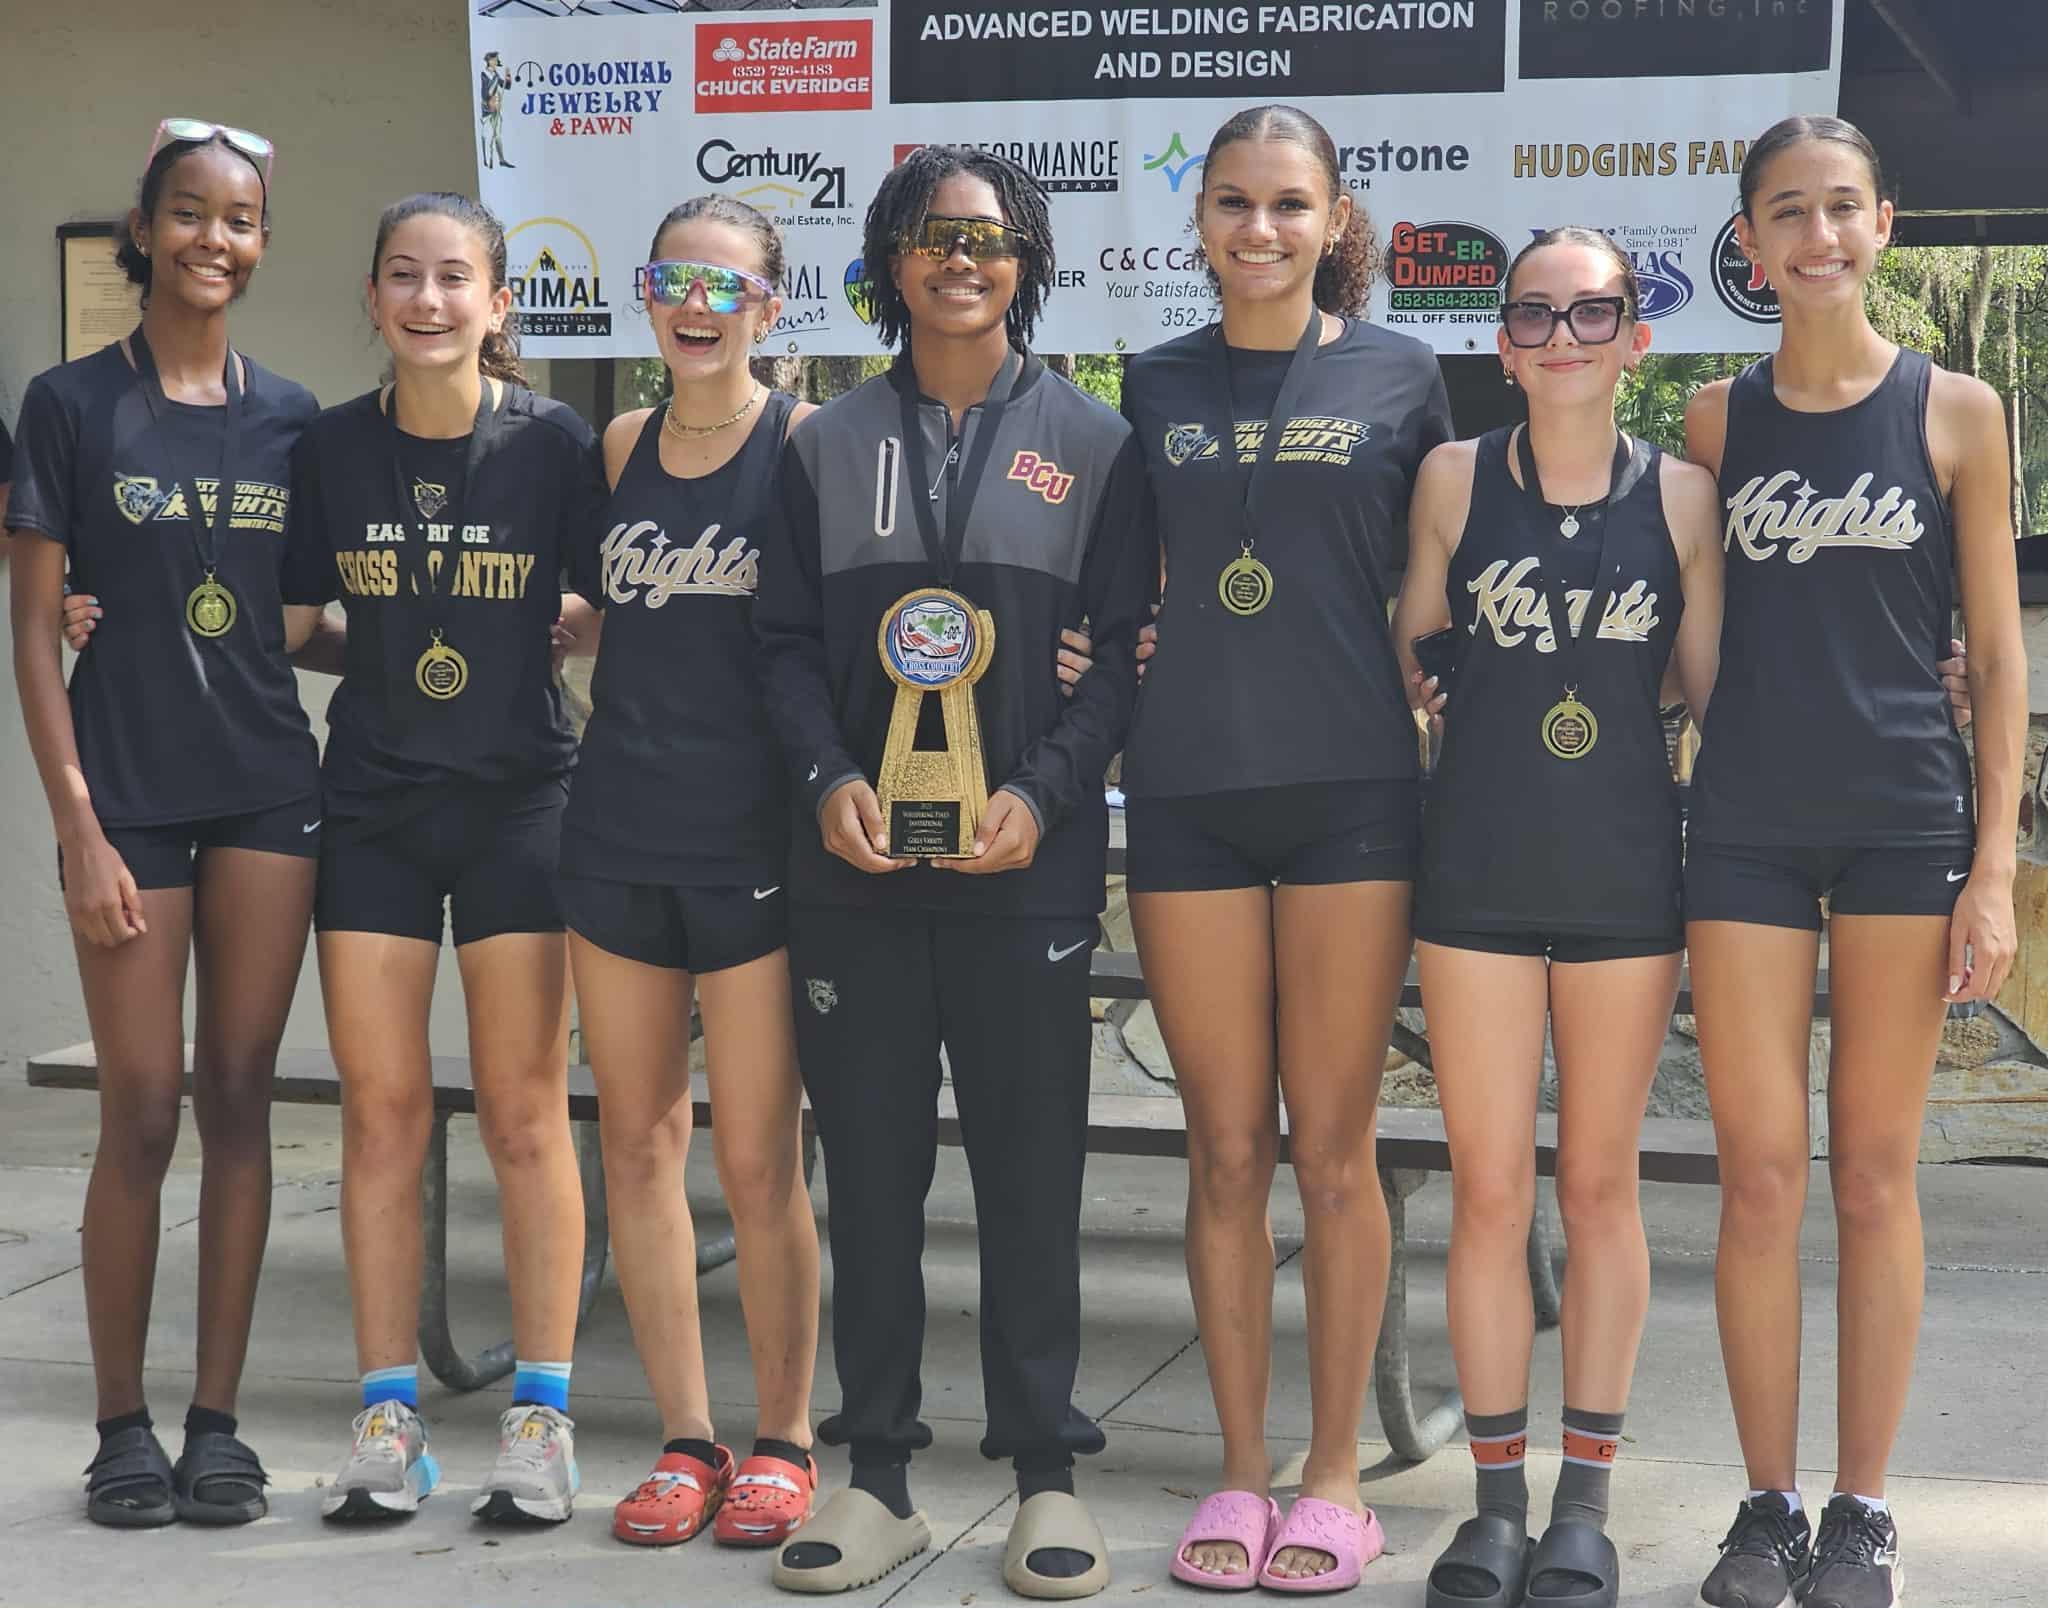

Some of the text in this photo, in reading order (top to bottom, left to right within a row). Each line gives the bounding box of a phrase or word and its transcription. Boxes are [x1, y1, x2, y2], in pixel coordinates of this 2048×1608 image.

[920, 1, 1475, 41] ADVANCED WELDING FABRICATION
[549, 61, 672, 86] COLONIAL
[732, 65, 766, 78] (352)
[1094, 50, 1292, 79] AND DESIGN
[696, 77, 869, 96] CHUCK EVERIDGE
[521, 89, 663, 115] JEWELRY
[550, 116, 633, 136] & PAWN
[696, 138, 822, 184] Century
[1338, 139, 1470, 173] rstone
[1513, 142, 1677, 178] HUDGINS
[809, 166, 846, 209] 21
[1047, 182, 1112, 191] ERAPY
[774, 215, 855, 227] Real Estate, Inc.
[1660, 224, 1697, 235] Owned
[1625, 238, 1654, 248] Since
[1100, 247, 1115, 271] C
[1120, 247, 1136, 271] &
[1143, 247, 1159, 271] C
[1394, 257, 1497, 286] DUMPED
[509, 277, 609, 307] RIMAL
[1106, 281, 1214, 298] Your Satisfac
[1393, 292, 1498, 309] 352-564-2333
[522, 324, 608, 334] SSFIT PBA
[1386, 313, 1418, 324] ROLL
[1422, 313, 1447, 324] OFF
[1007, 450, 1075, 504] BCU
[1724, 470, 1925, 564] Knights
[366, 523, 490, 544] EAS RIGE
[335, 550, 399, 596] CROSS
[600, 520, 760, 609] Knights
